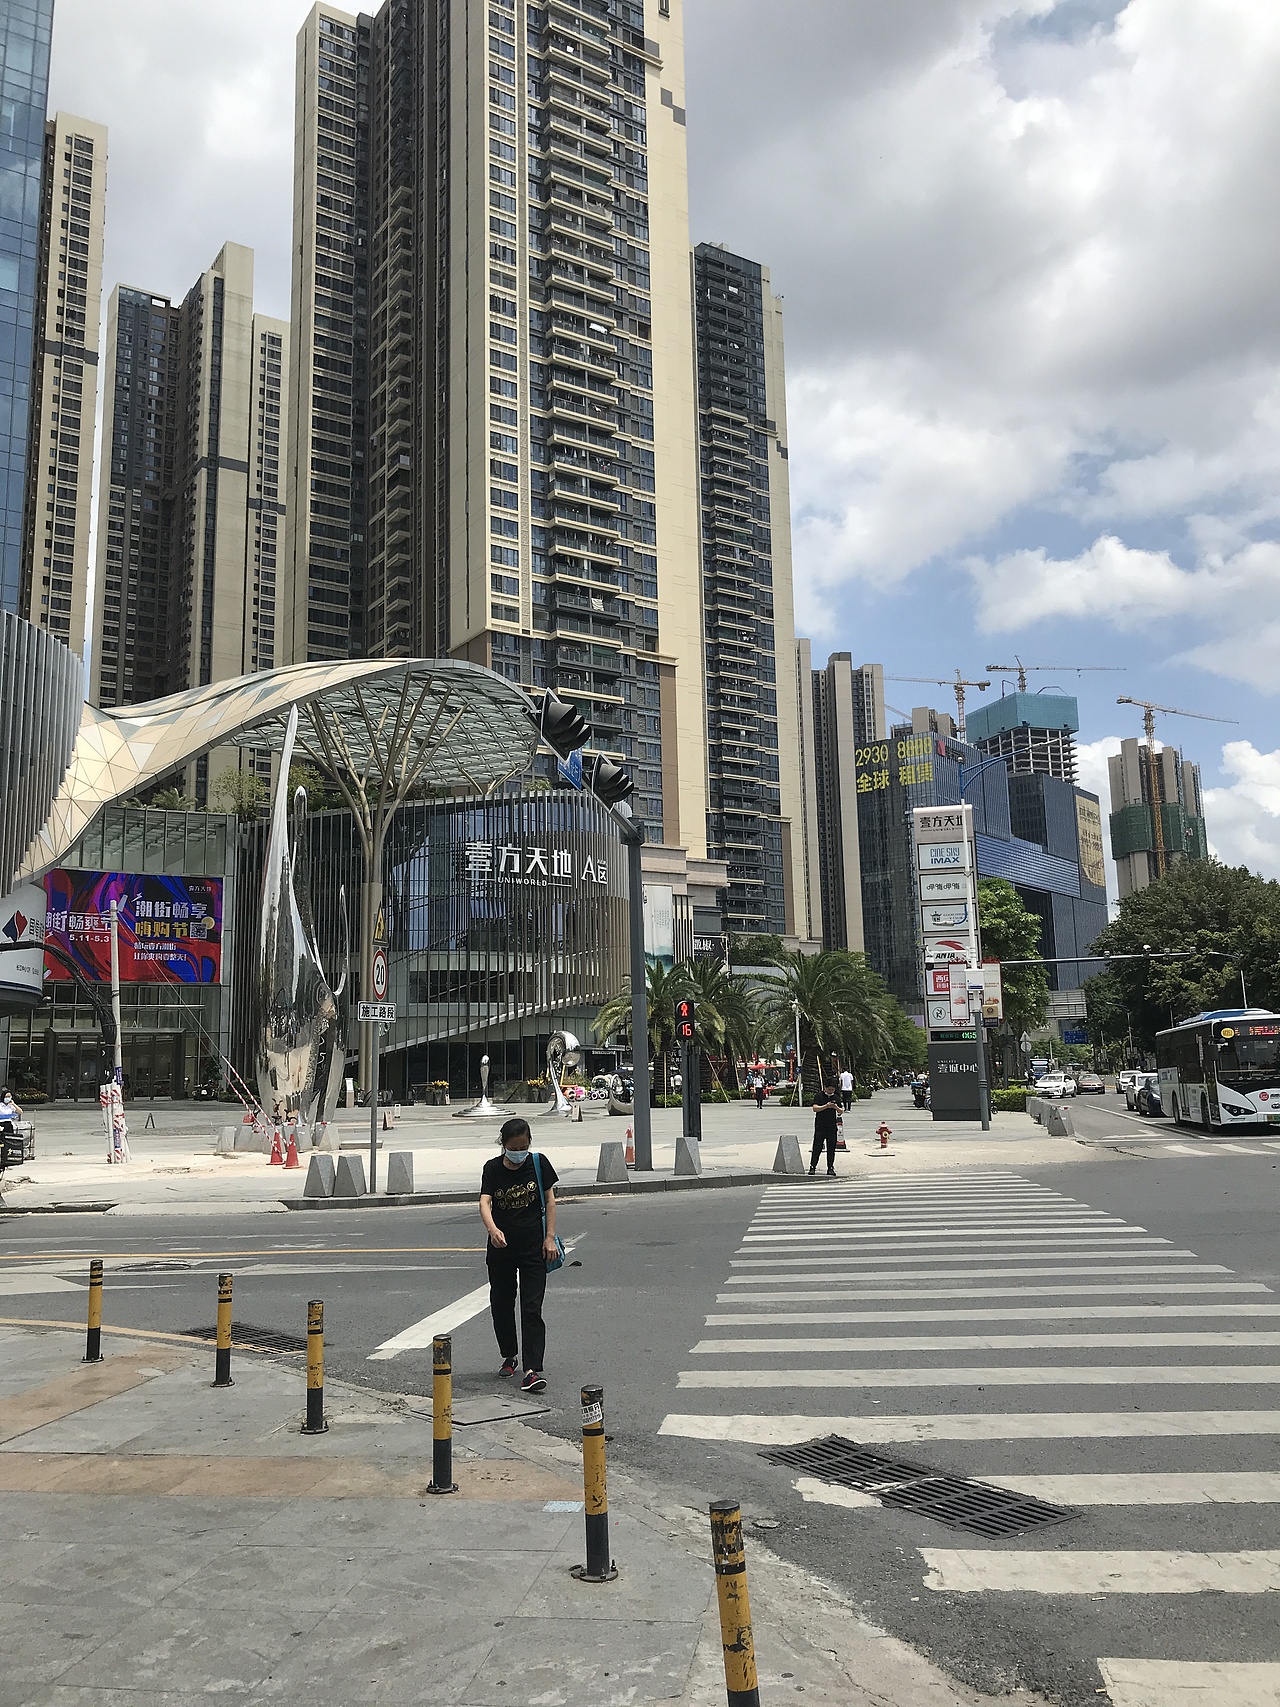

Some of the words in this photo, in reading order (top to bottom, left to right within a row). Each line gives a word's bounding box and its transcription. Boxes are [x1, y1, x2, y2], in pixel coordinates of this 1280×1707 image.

[855, 744, 889, 767] 2930
[897, 736, 932, 759] 8888
[856, 768, 890, 793] 全球
[464, 841, 572, 878] 壹方天地
[930, 856, 960, 865] IMAX
[580, 854, 608, 885] A区
[497, 876, 547, 886] UNIWORLD
[135, 900, 208, 919] 潮街畅享
[135, 920, 188, 938] 嗨购节
[375, 964, 385, 986] 20
[361, 1004, 395, 1019] 施工路段
[682, 1023, 692, 1036] 16
